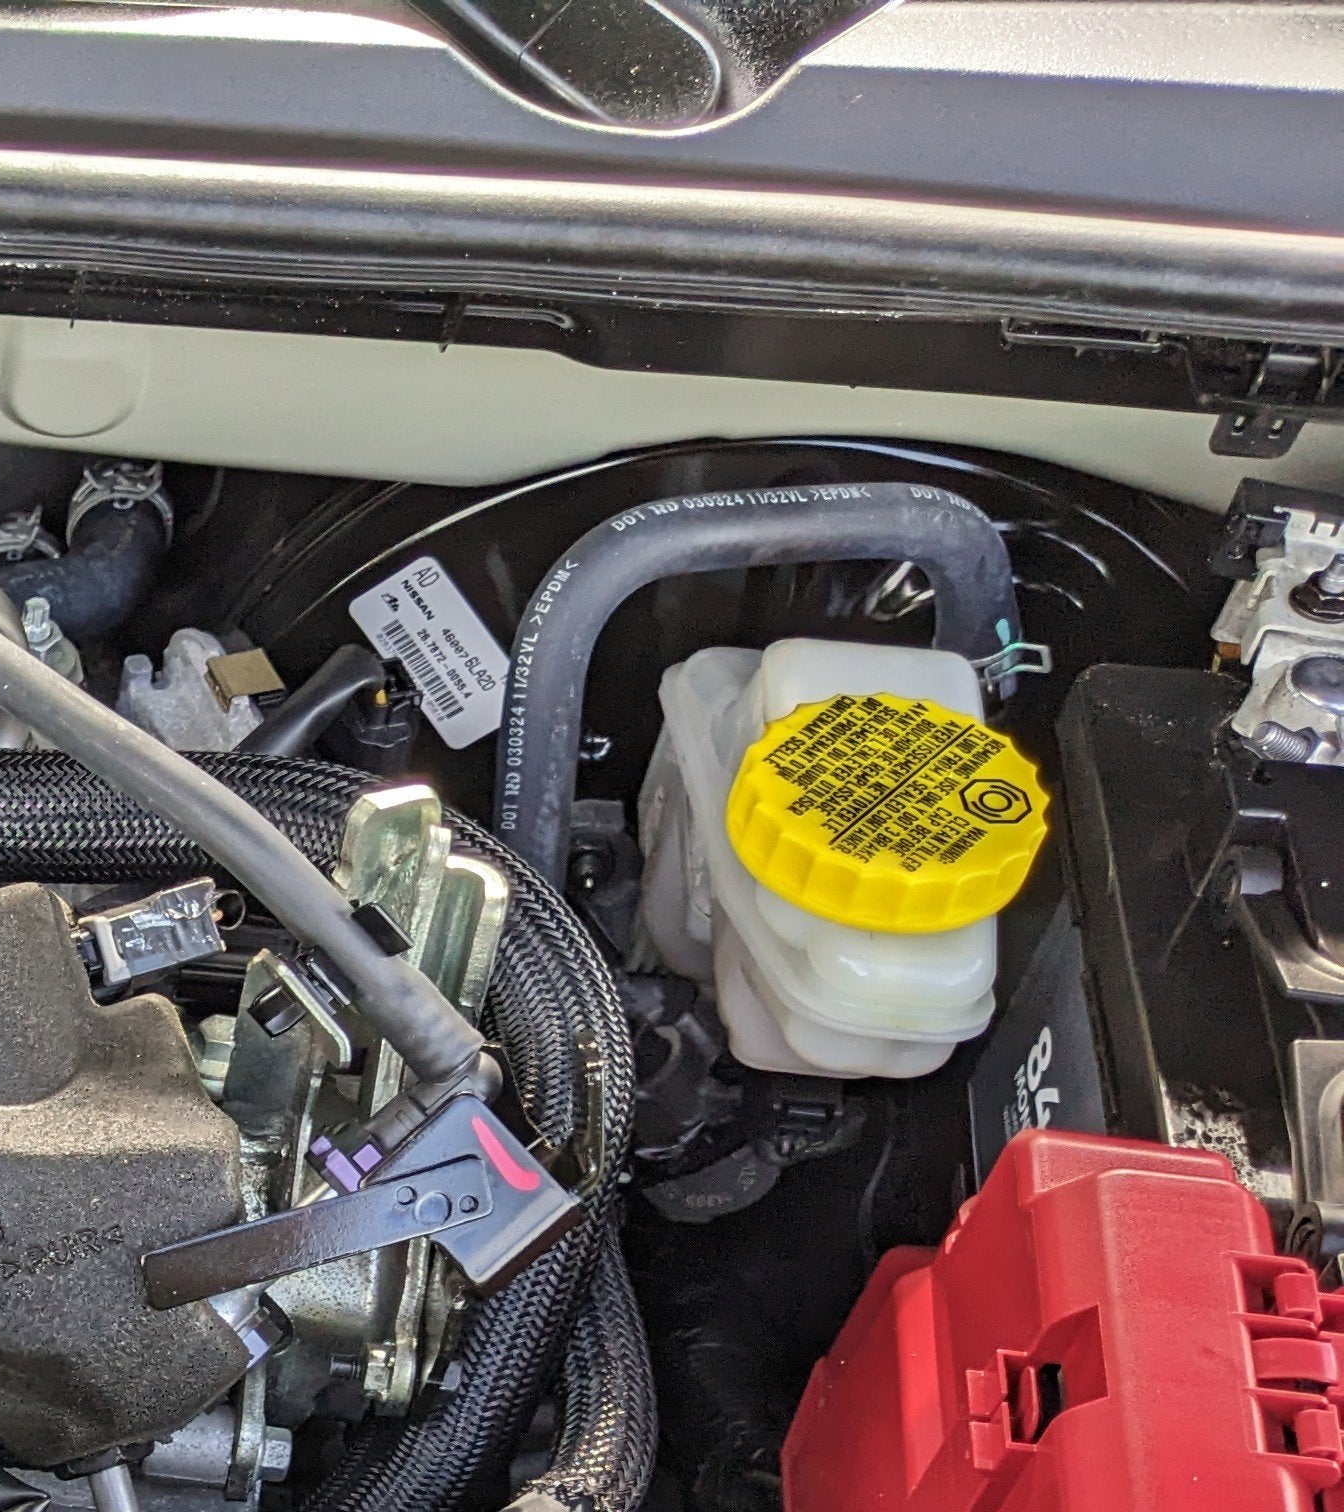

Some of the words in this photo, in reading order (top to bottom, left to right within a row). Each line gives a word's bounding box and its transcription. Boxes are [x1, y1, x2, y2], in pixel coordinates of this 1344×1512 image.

[612, 510, 647, 531] DOT
[413, 564, 440, 588] AD
[400, 577, 435, 622] NISSAN
[797, 694, 857, 742] CONTENANT
[857, 696, 882, 715] DOT
[891, 701, 929, 731] AVANT
[798, 717, 857, 764] PROVENANT
[838, 704, 899, 753] SEULEMENT
[884, 715, 936, 758] BOUCHON
[955, 727, 989, 755] FLUID
[791, 759, 832, 791] LIQUIDE
[928, 750, 962, 776] FROM
[785, 779, 833, 817] UTILISER
[813, 760, 882, 816] REMPLISSAGE
[834, 777, 886, 824] NETTOYER
[885, 780, 926, 813] SEALED
[934, 776, 959, 796] USE
[911, 791, 941, 815] ONLY
[925, 805, 952, 826] CAP
[893, 812, 917, 831] DOT
[929, 814, 969, 847] CLEAN
[852, 831, 892, 864] BRAKE
[887, 824, 929, 858] BEFORE
[899, 840, 940, 874] FILLER
